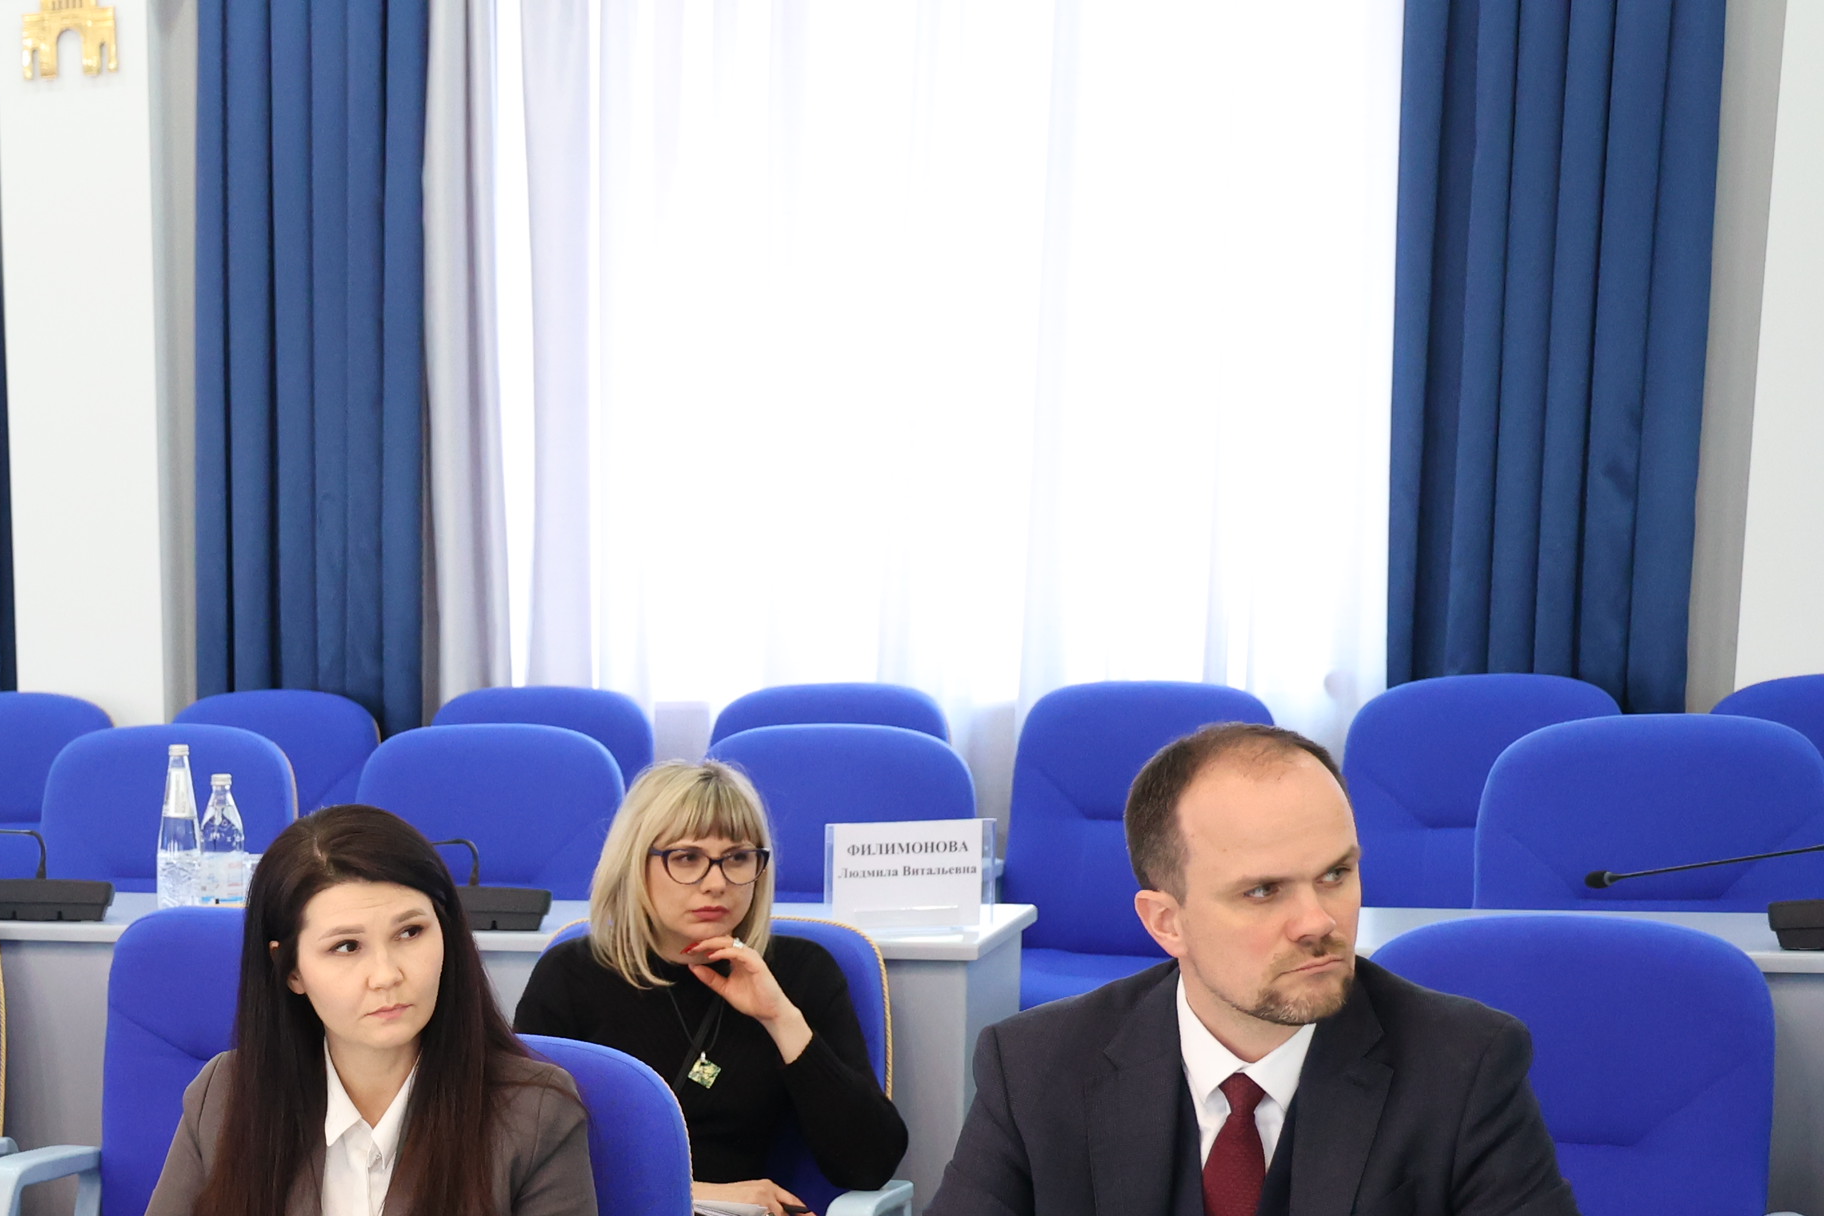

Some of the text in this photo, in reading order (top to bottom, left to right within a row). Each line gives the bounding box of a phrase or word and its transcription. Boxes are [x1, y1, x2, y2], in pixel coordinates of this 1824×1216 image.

[847, 840, 969, 856] ФИЛИМОНОВА
[838, 864, 977, 880] Людмила Витальевна
